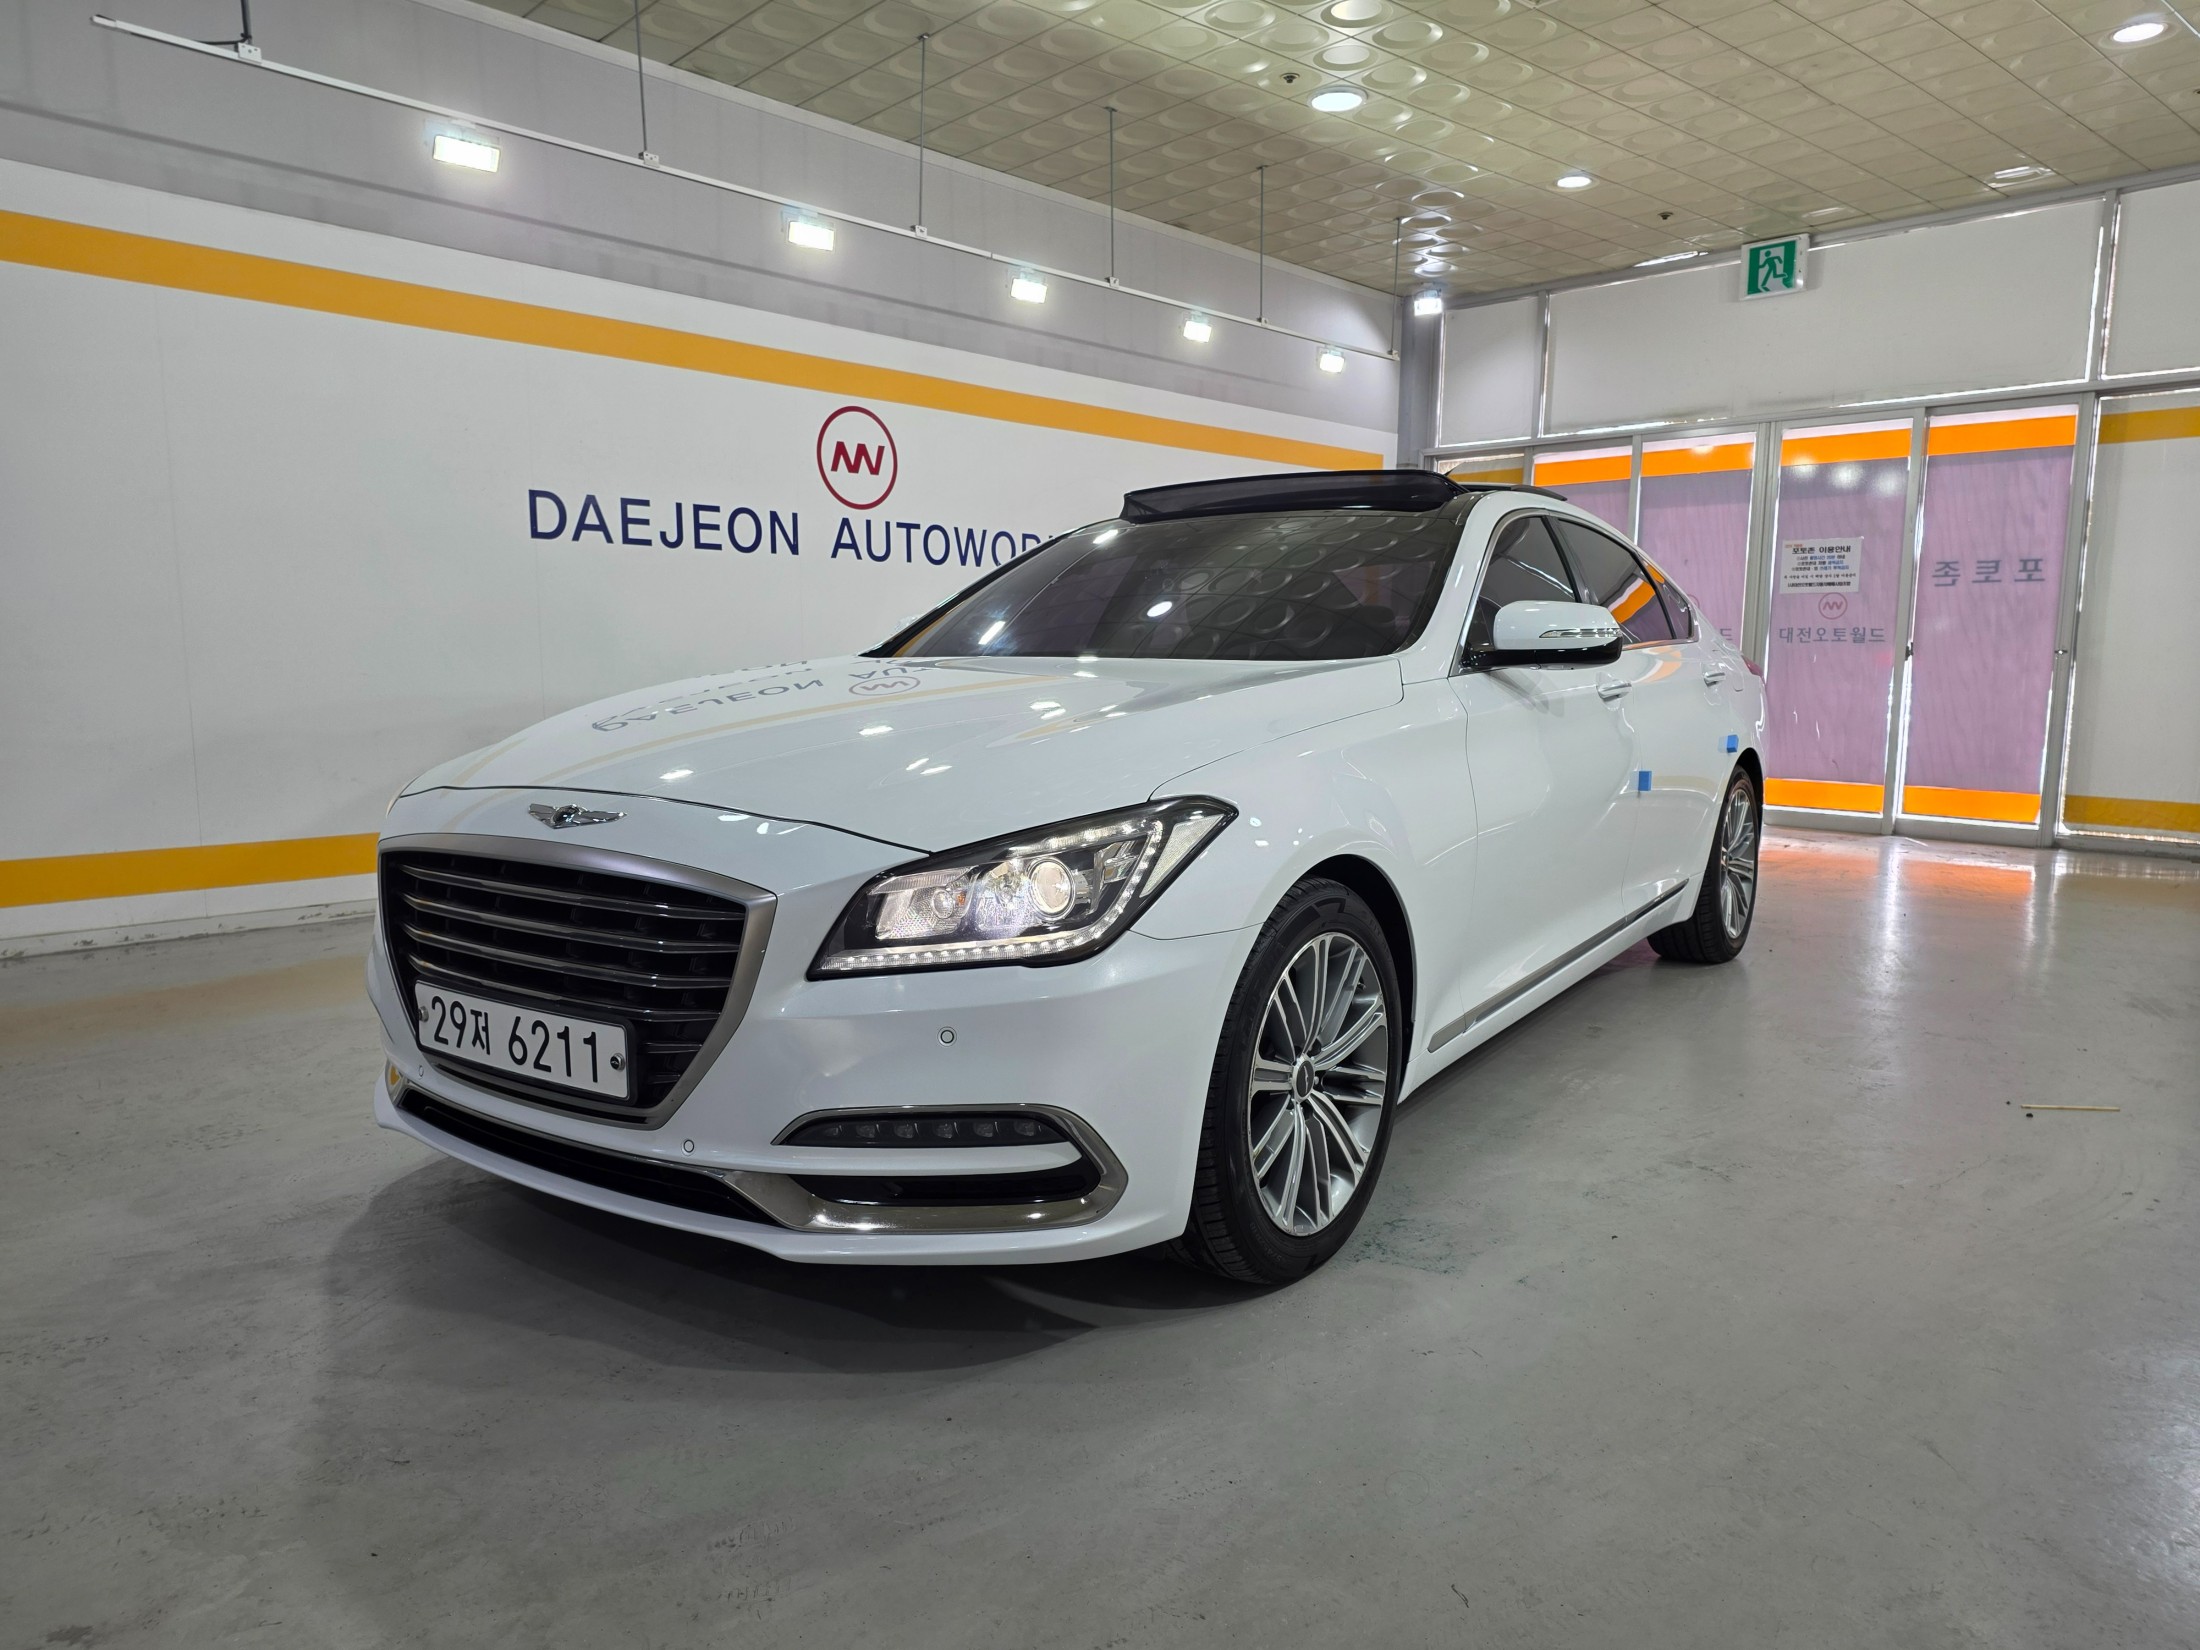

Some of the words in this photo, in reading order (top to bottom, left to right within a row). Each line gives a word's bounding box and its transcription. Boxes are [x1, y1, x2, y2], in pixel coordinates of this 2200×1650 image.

[528, 489, 799, 556] DAEJEON
[831, 517, 1053, 567] AUTOWO
[1778, 626, 1886, 644] 대전오토월드
[431, 995, 491, 1056] 29저
[508, 1016, 598, 1083] 6211
